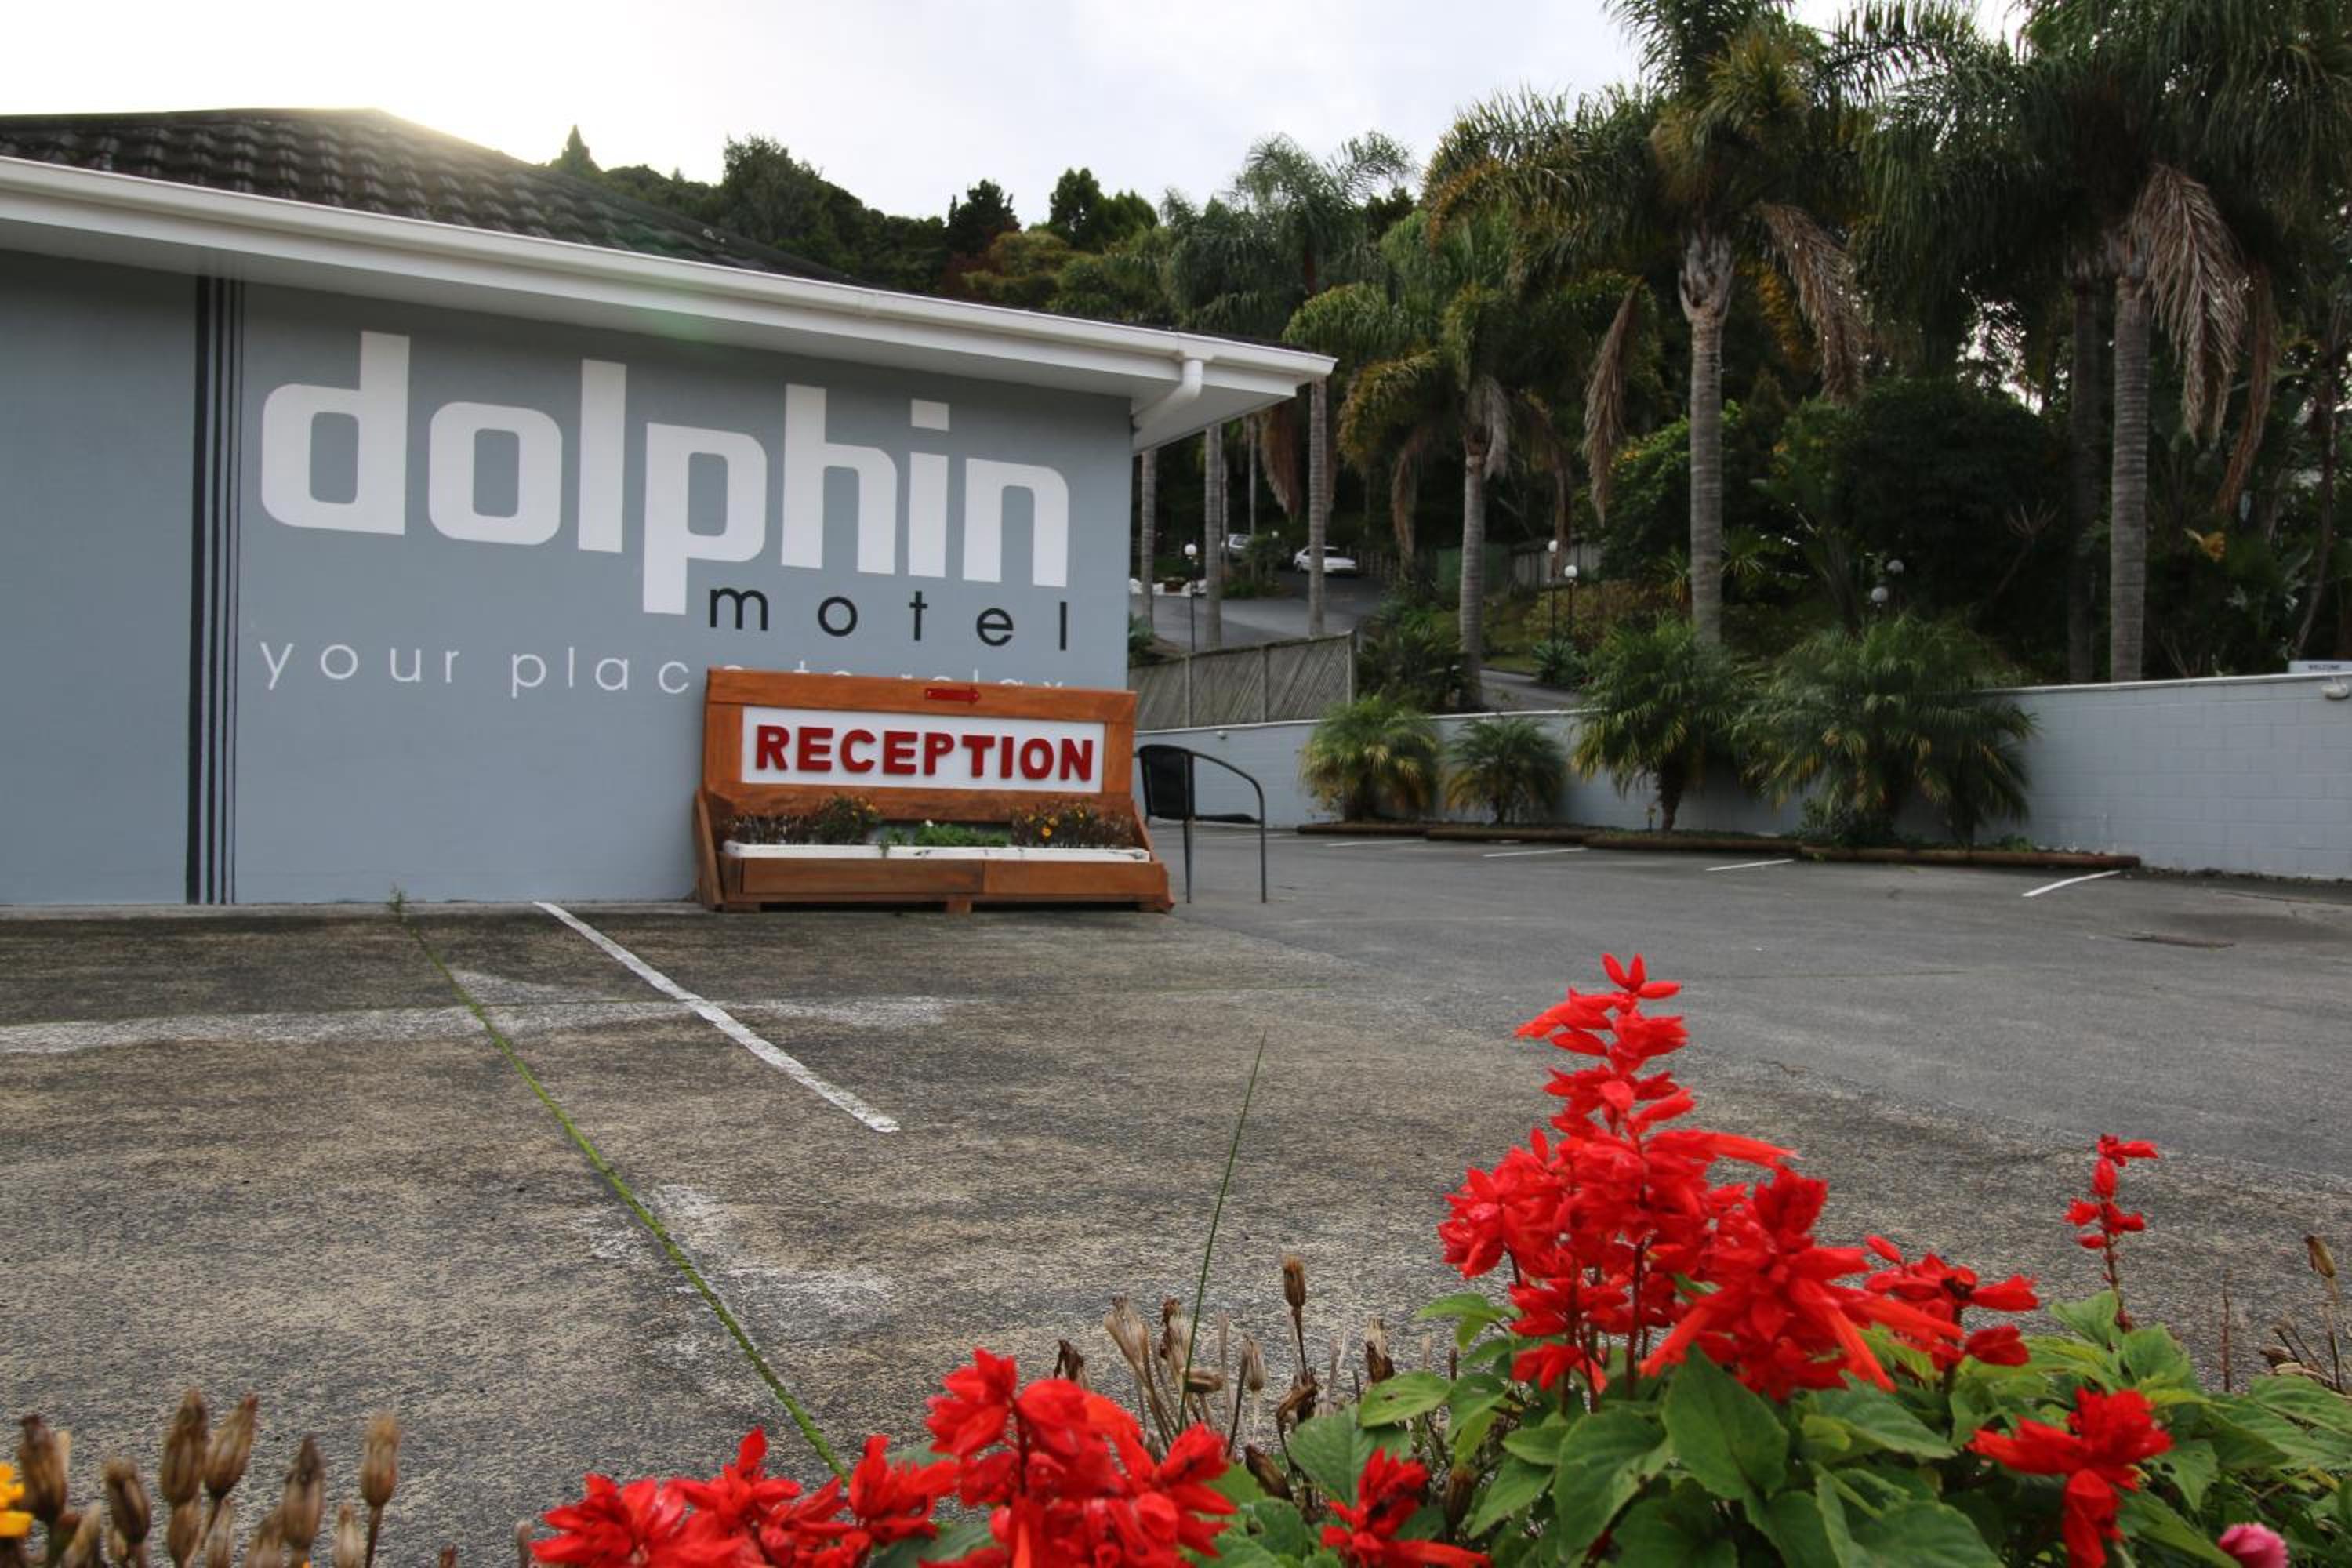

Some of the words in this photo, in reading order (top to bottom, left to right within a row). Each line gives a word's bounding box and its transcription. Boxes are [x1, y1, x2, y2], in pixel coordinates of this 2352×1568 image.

[261, 332, 1069, 615] dolphin
[710, 587, 1068, 651] motel
[260, 642, 459, 691] your
[511, 646, 744, 699] plac
[756, 724, 1094, 781] RECEPTION
